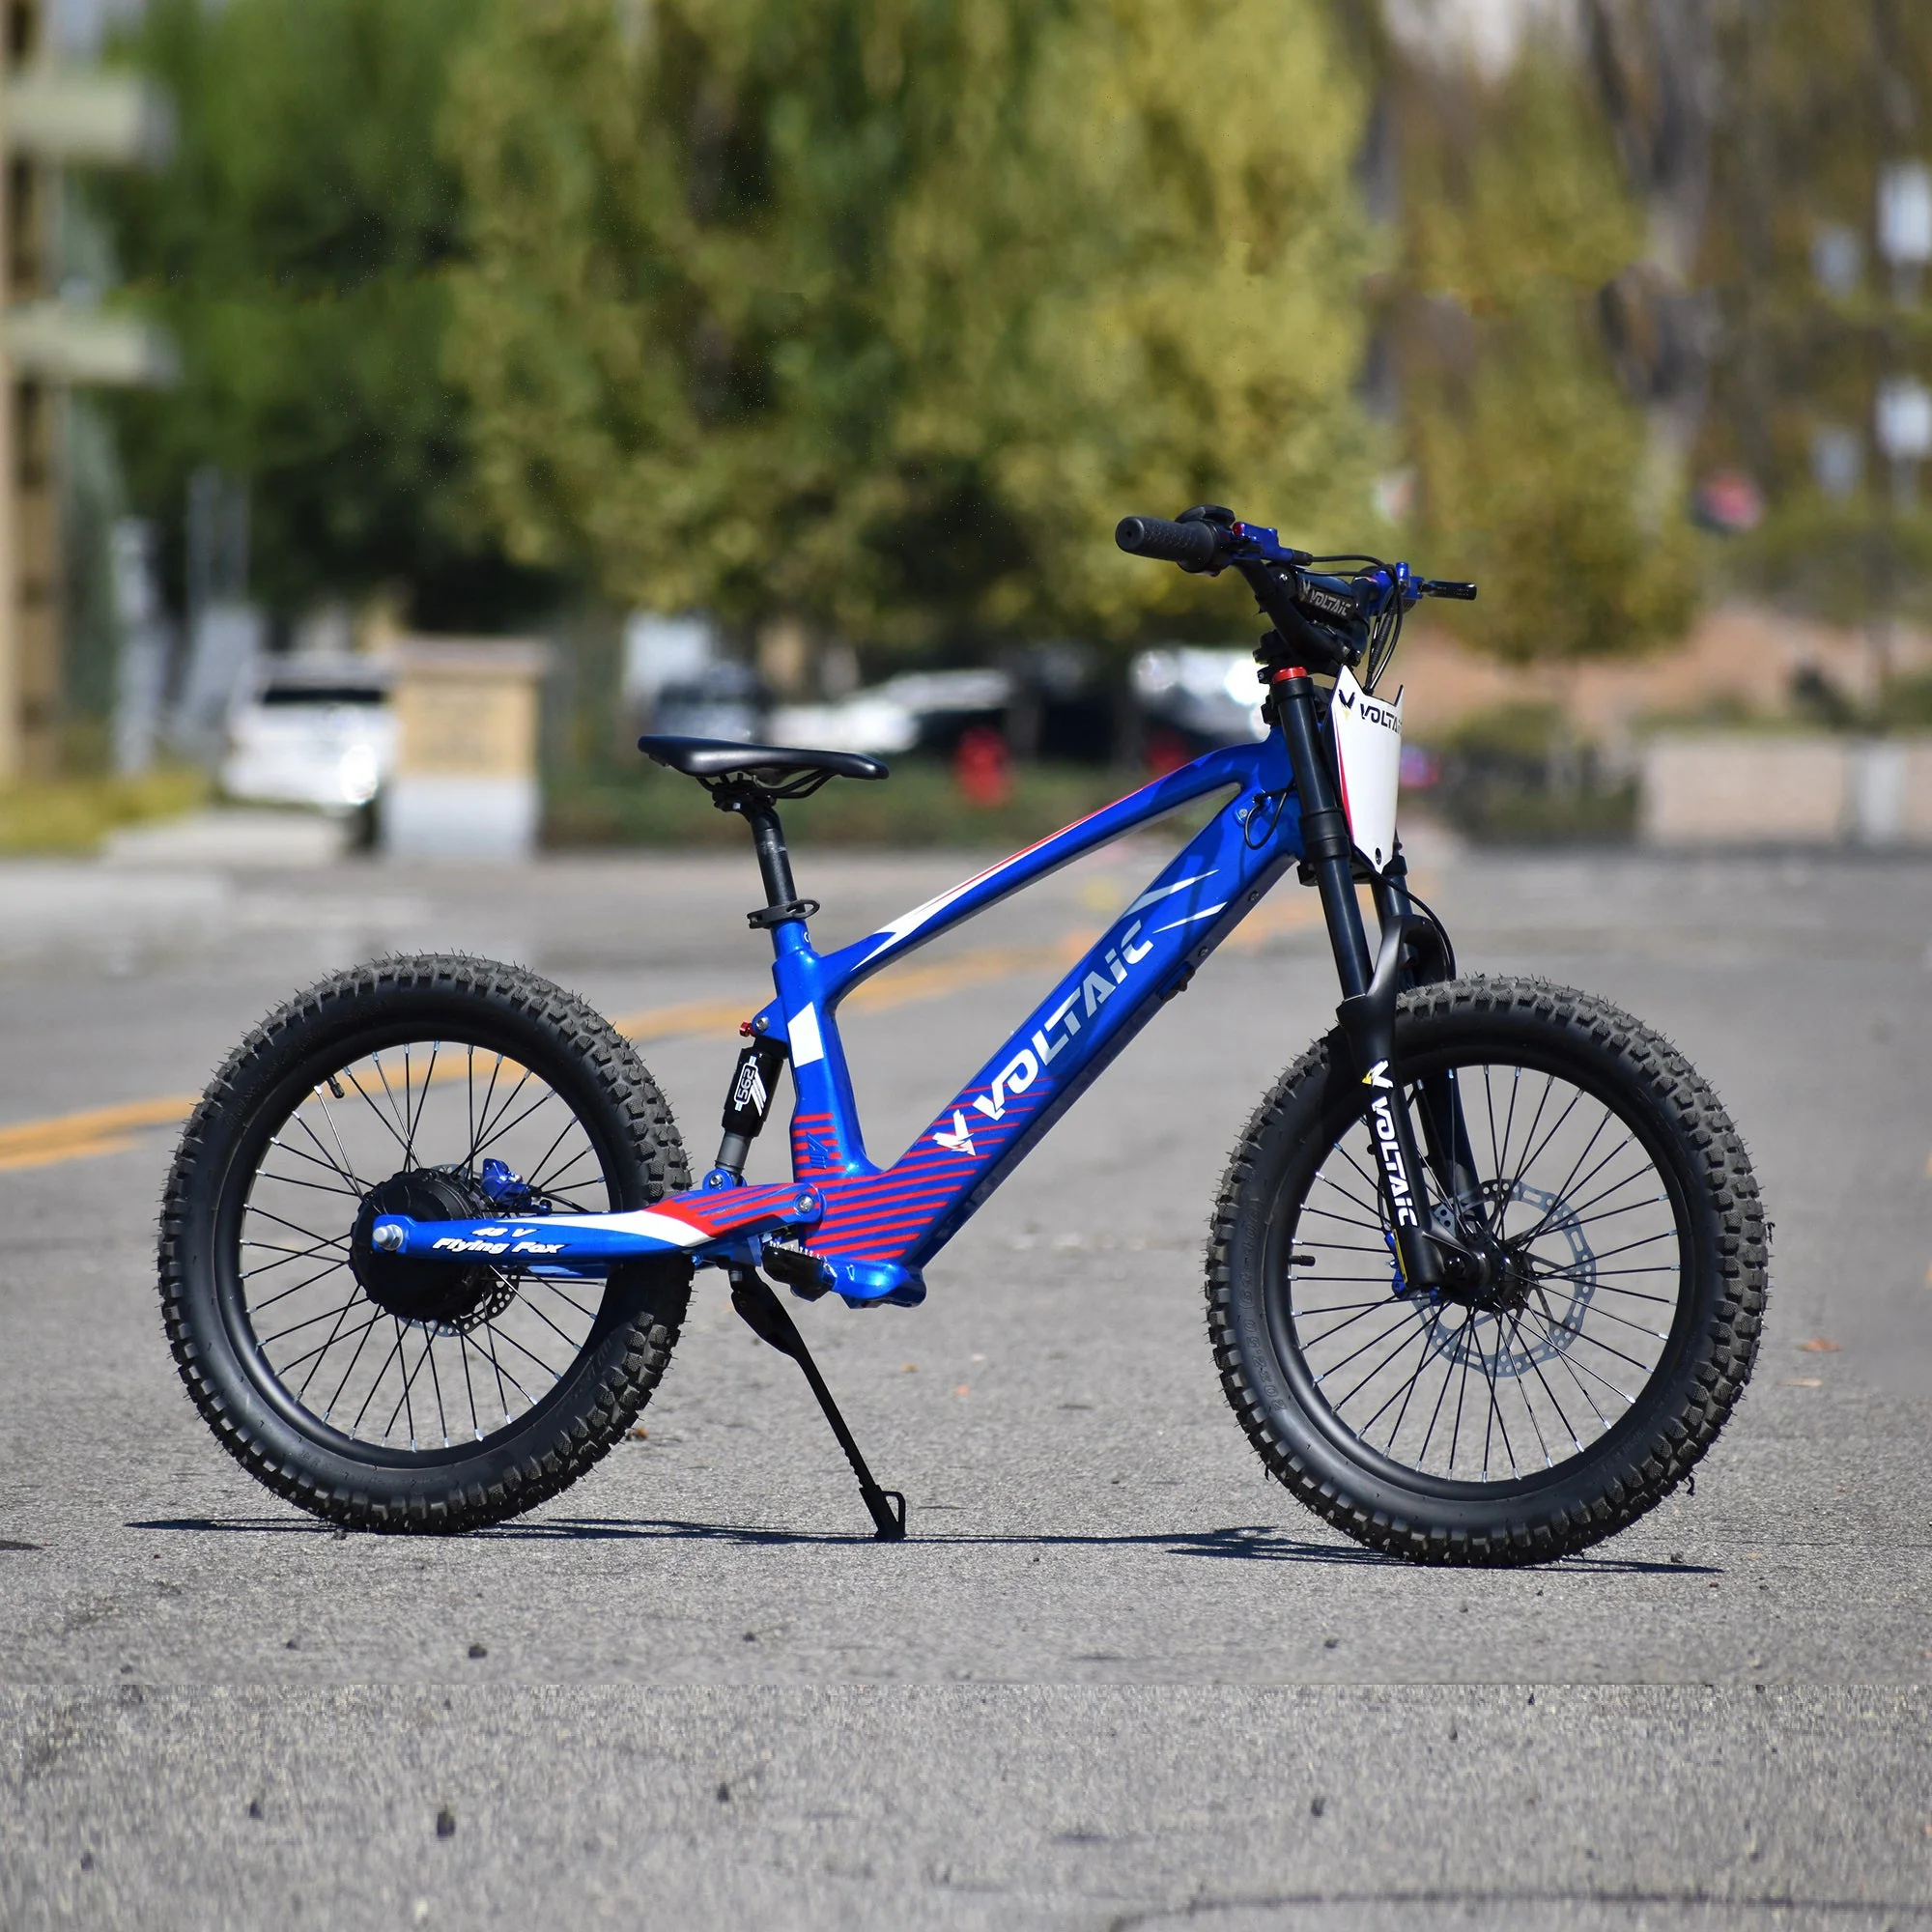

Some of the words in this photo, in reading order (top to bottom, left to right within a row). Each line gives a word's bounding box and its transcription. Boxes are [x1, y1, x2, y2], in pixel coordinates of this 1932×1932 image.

[737, 1067, 755, 1100] 562
[511, 1228, 538, 1237] V
[432, 1237, 511, 1255] Flying
[511, 1241, 566, 1254] Fox
